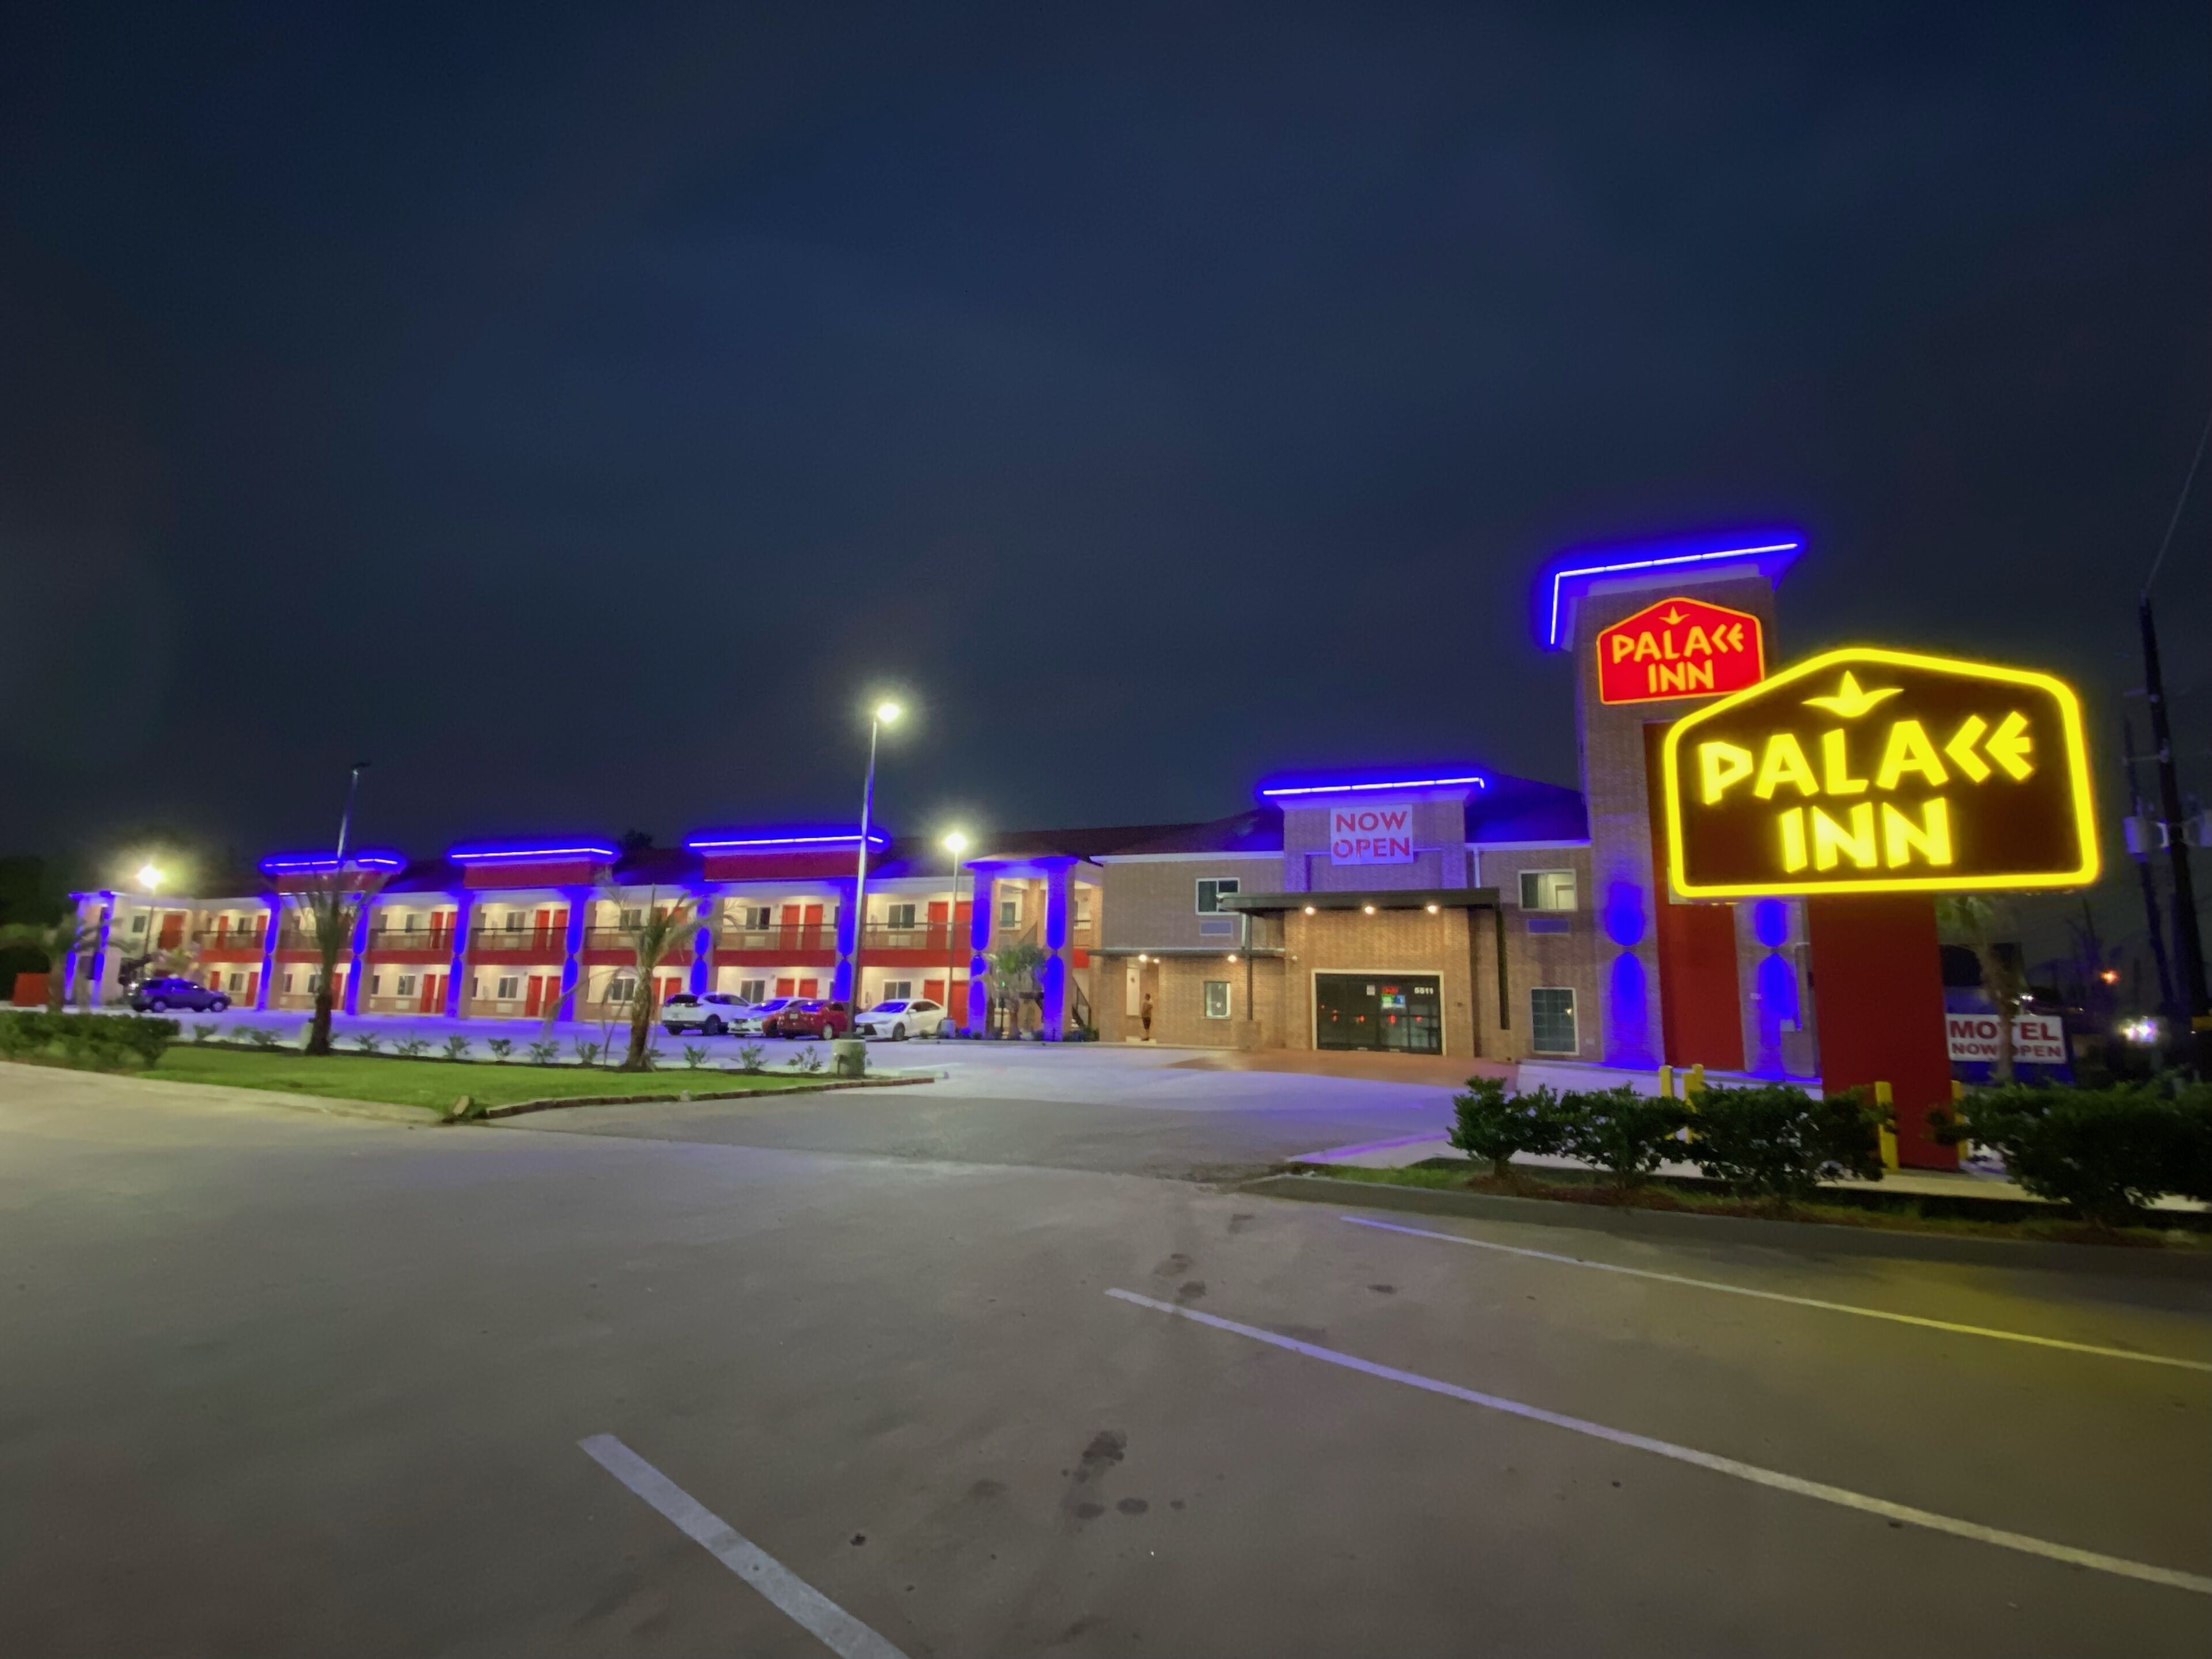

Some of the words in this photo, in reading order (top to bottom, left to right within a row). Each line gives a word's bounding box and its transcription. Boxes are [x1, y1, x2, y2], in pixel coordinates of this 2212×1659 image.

[1612, 623, 1744, 664] PALACE
[1648, 659, 1714, 694] INN
[1698, 711, 2035, 805] PALACE
[1336, 810, 1407, 832] NOW
[1333, 837, 1410, 858] OPEN
[1778, 797, 1953, 874] INN
[1949, 1020, 2059, 1041] MOEL
[1951, 1043, 1997, 1055] NOW
